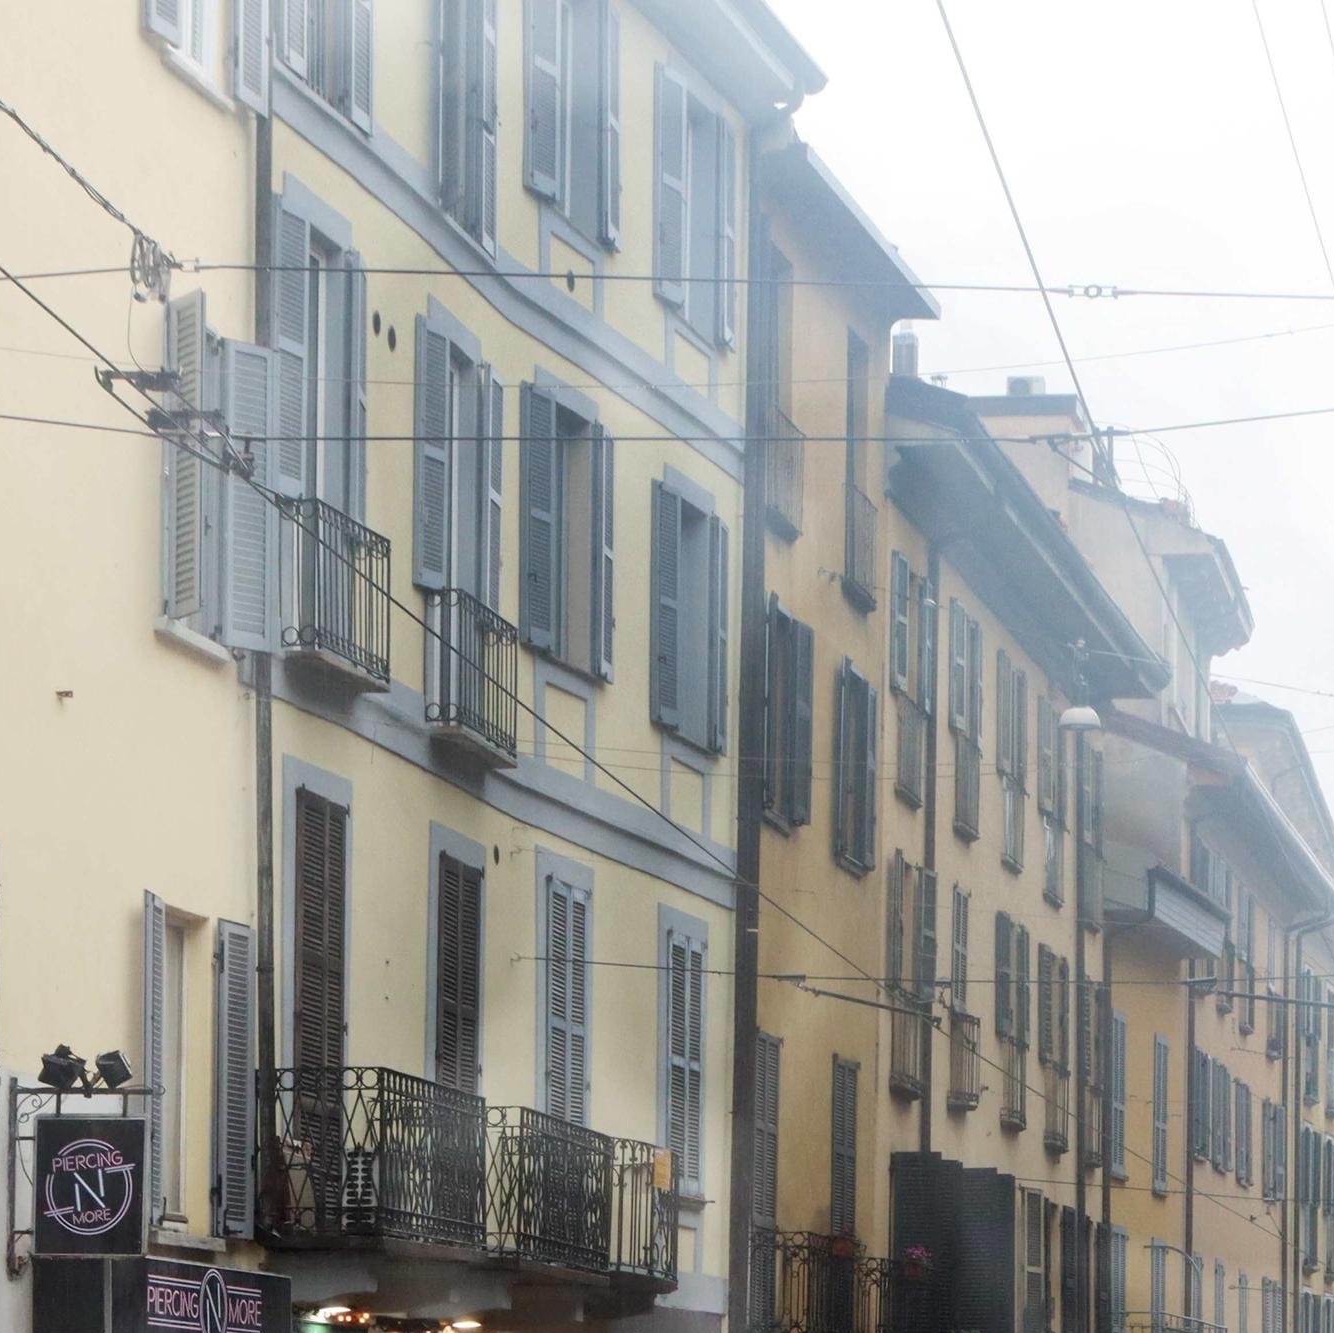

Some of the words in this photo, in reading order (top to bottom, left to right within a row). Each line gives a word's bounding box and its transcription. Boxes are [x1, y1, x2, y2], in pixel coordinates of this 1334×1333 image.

[51, 1149, 123, 1173] PIERCING
[73, 1168, 106, 1212] N
[72, 1208, 112, 1225] MORE
[147, 1285, 199, 1320] PIERCING
[228, 1296, 262, 1327] MORE
